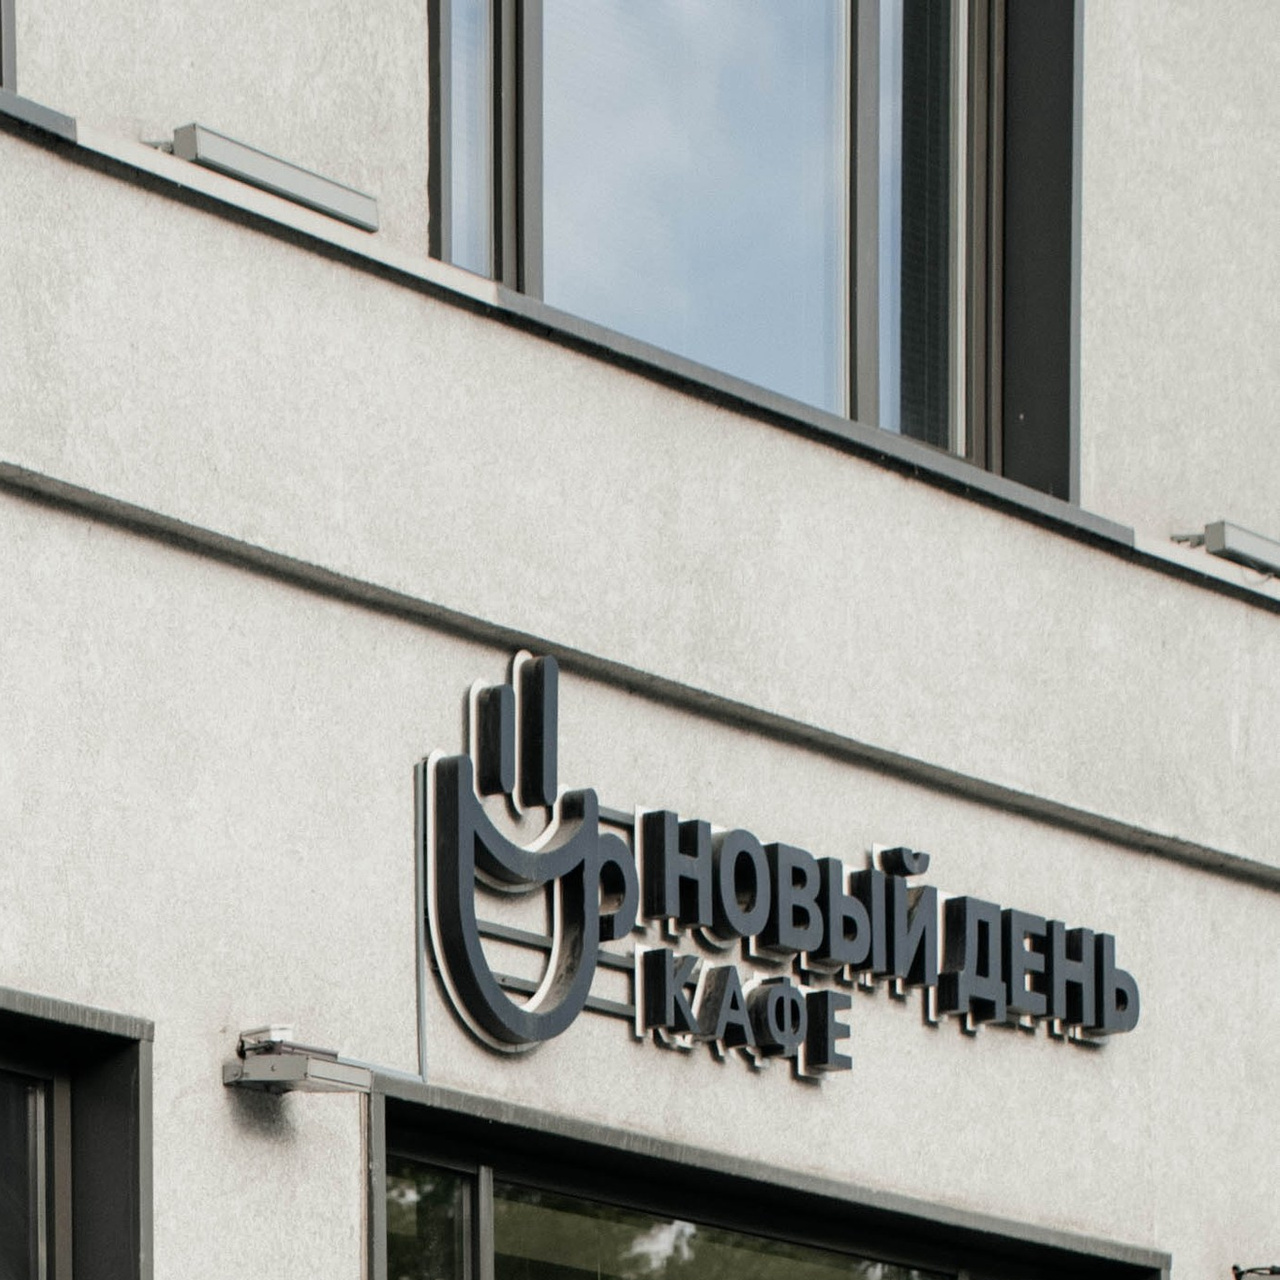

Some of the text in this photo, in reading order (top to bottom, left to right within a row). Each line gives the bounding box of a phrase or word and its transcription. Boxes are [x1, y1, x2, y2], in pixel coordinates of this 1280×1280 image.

[640, 809, 1141, 1036] НОВЫЙ ДЕНЬ
[640, 947, 852, 1072] КАФЕ
